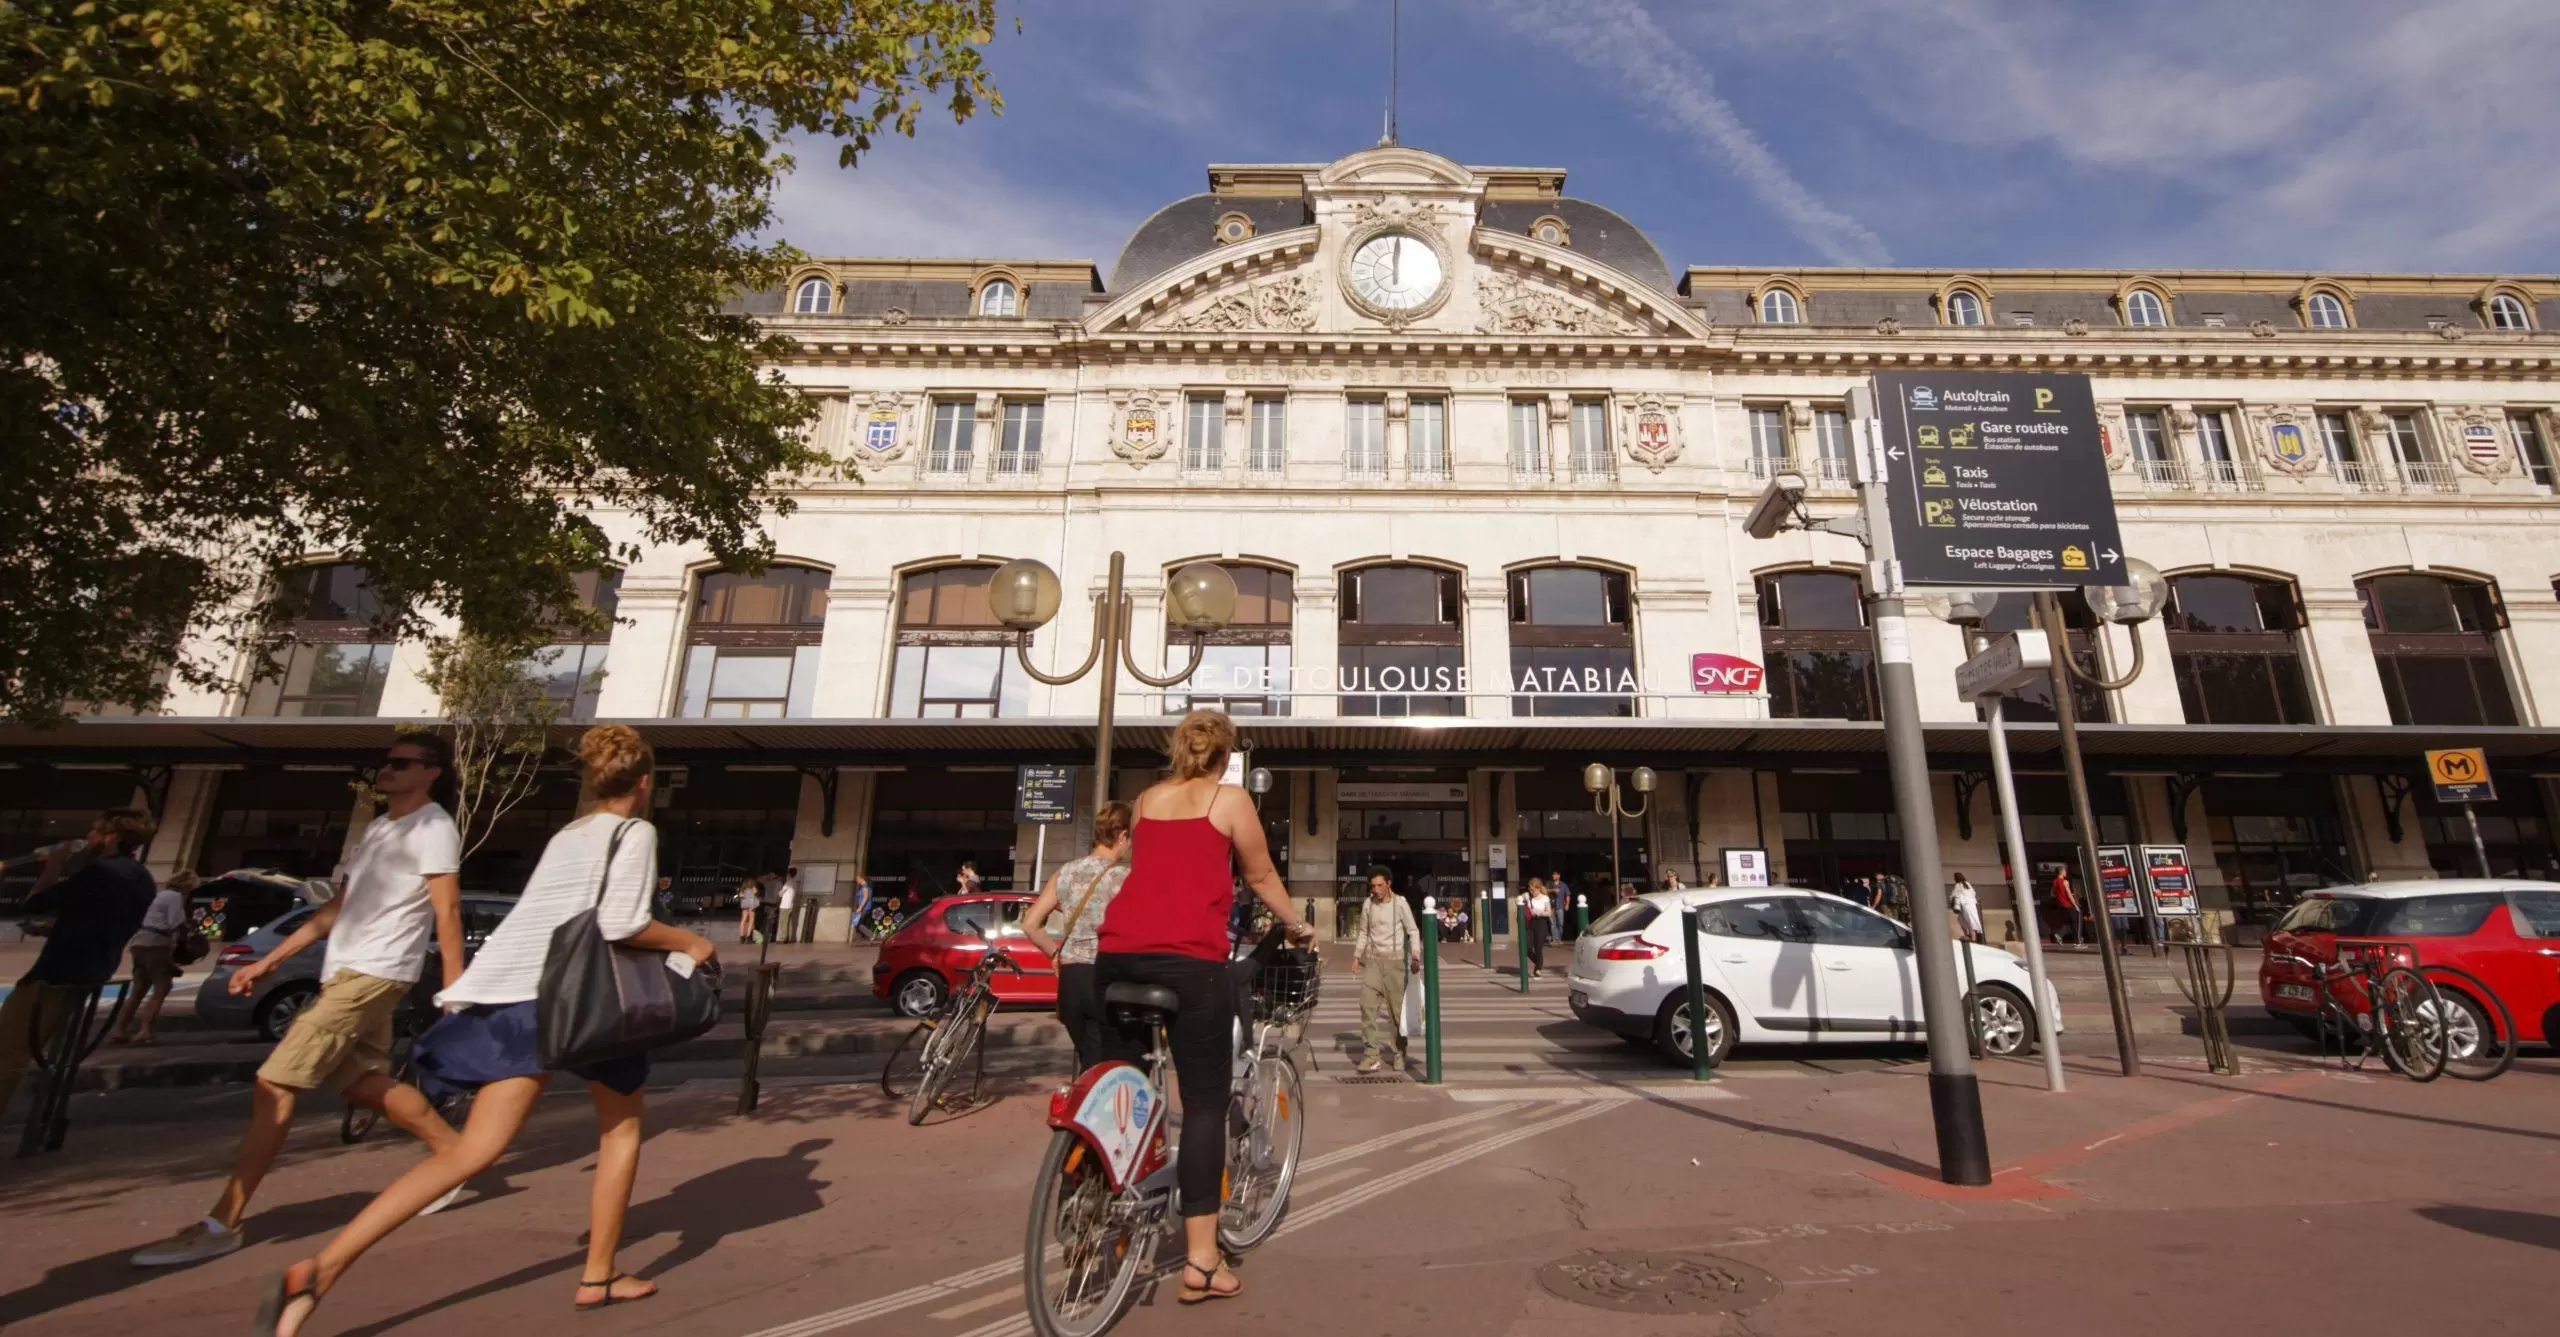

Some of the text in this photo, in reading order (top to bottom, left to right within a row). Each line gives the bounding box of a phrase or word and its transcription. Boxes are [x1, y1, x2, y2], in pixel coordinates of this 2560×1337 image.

[1225, 367, 1332, 381] CHEMINS
[1350, 369, 1381, 382] DE
[1465, 370, 1499, 383] DU
[1981, 422, 2069, 434] Gare routière
[1954, 466, 1988, 478] Taxis
[1958, 498, 2038, 511] Vélostation
[1945, 545, 2054, 561] Espace Bagages
[1233, 667, 1273, 691] DE
[1291, 667, 1472, 691] TOULOUSE
[1490, 667, 1661, 692] MATABIAU
[1695, 667, 1761, 686] SNCF
[2444, 758, 2471, 775] M
